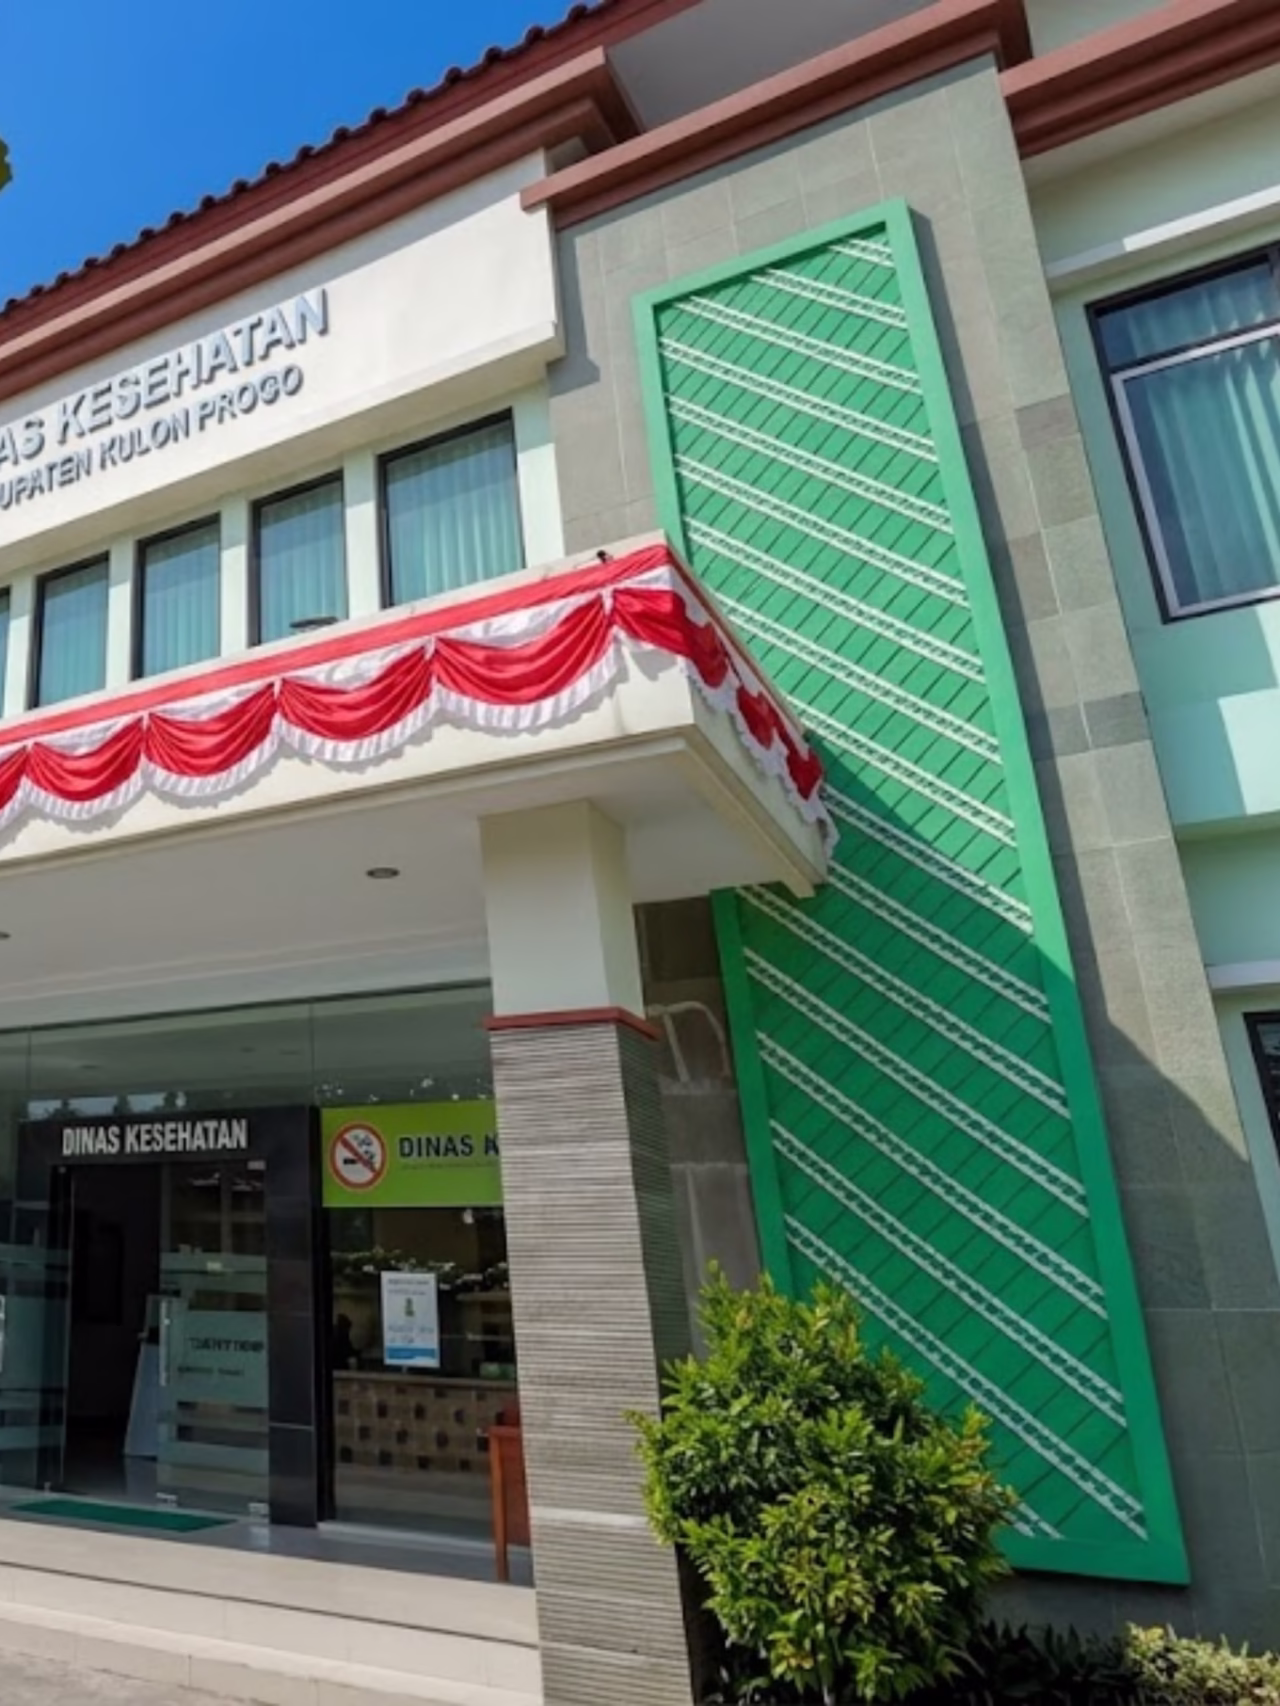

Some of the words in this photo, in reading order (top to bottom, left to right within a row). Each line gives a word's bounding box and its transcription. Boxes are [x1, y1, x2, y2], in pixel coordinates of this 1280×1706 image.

[56, 286, 329, 446] KESEHATAN
[99, 406, 190, 471] KULON
[195, 363, 304, 432] PROGO
[62, 1125, 120, 1156] DINAS
[124, 1118, 248, 1154] KESEHATAN
[398, 1134, 474, 1158] DINAS
